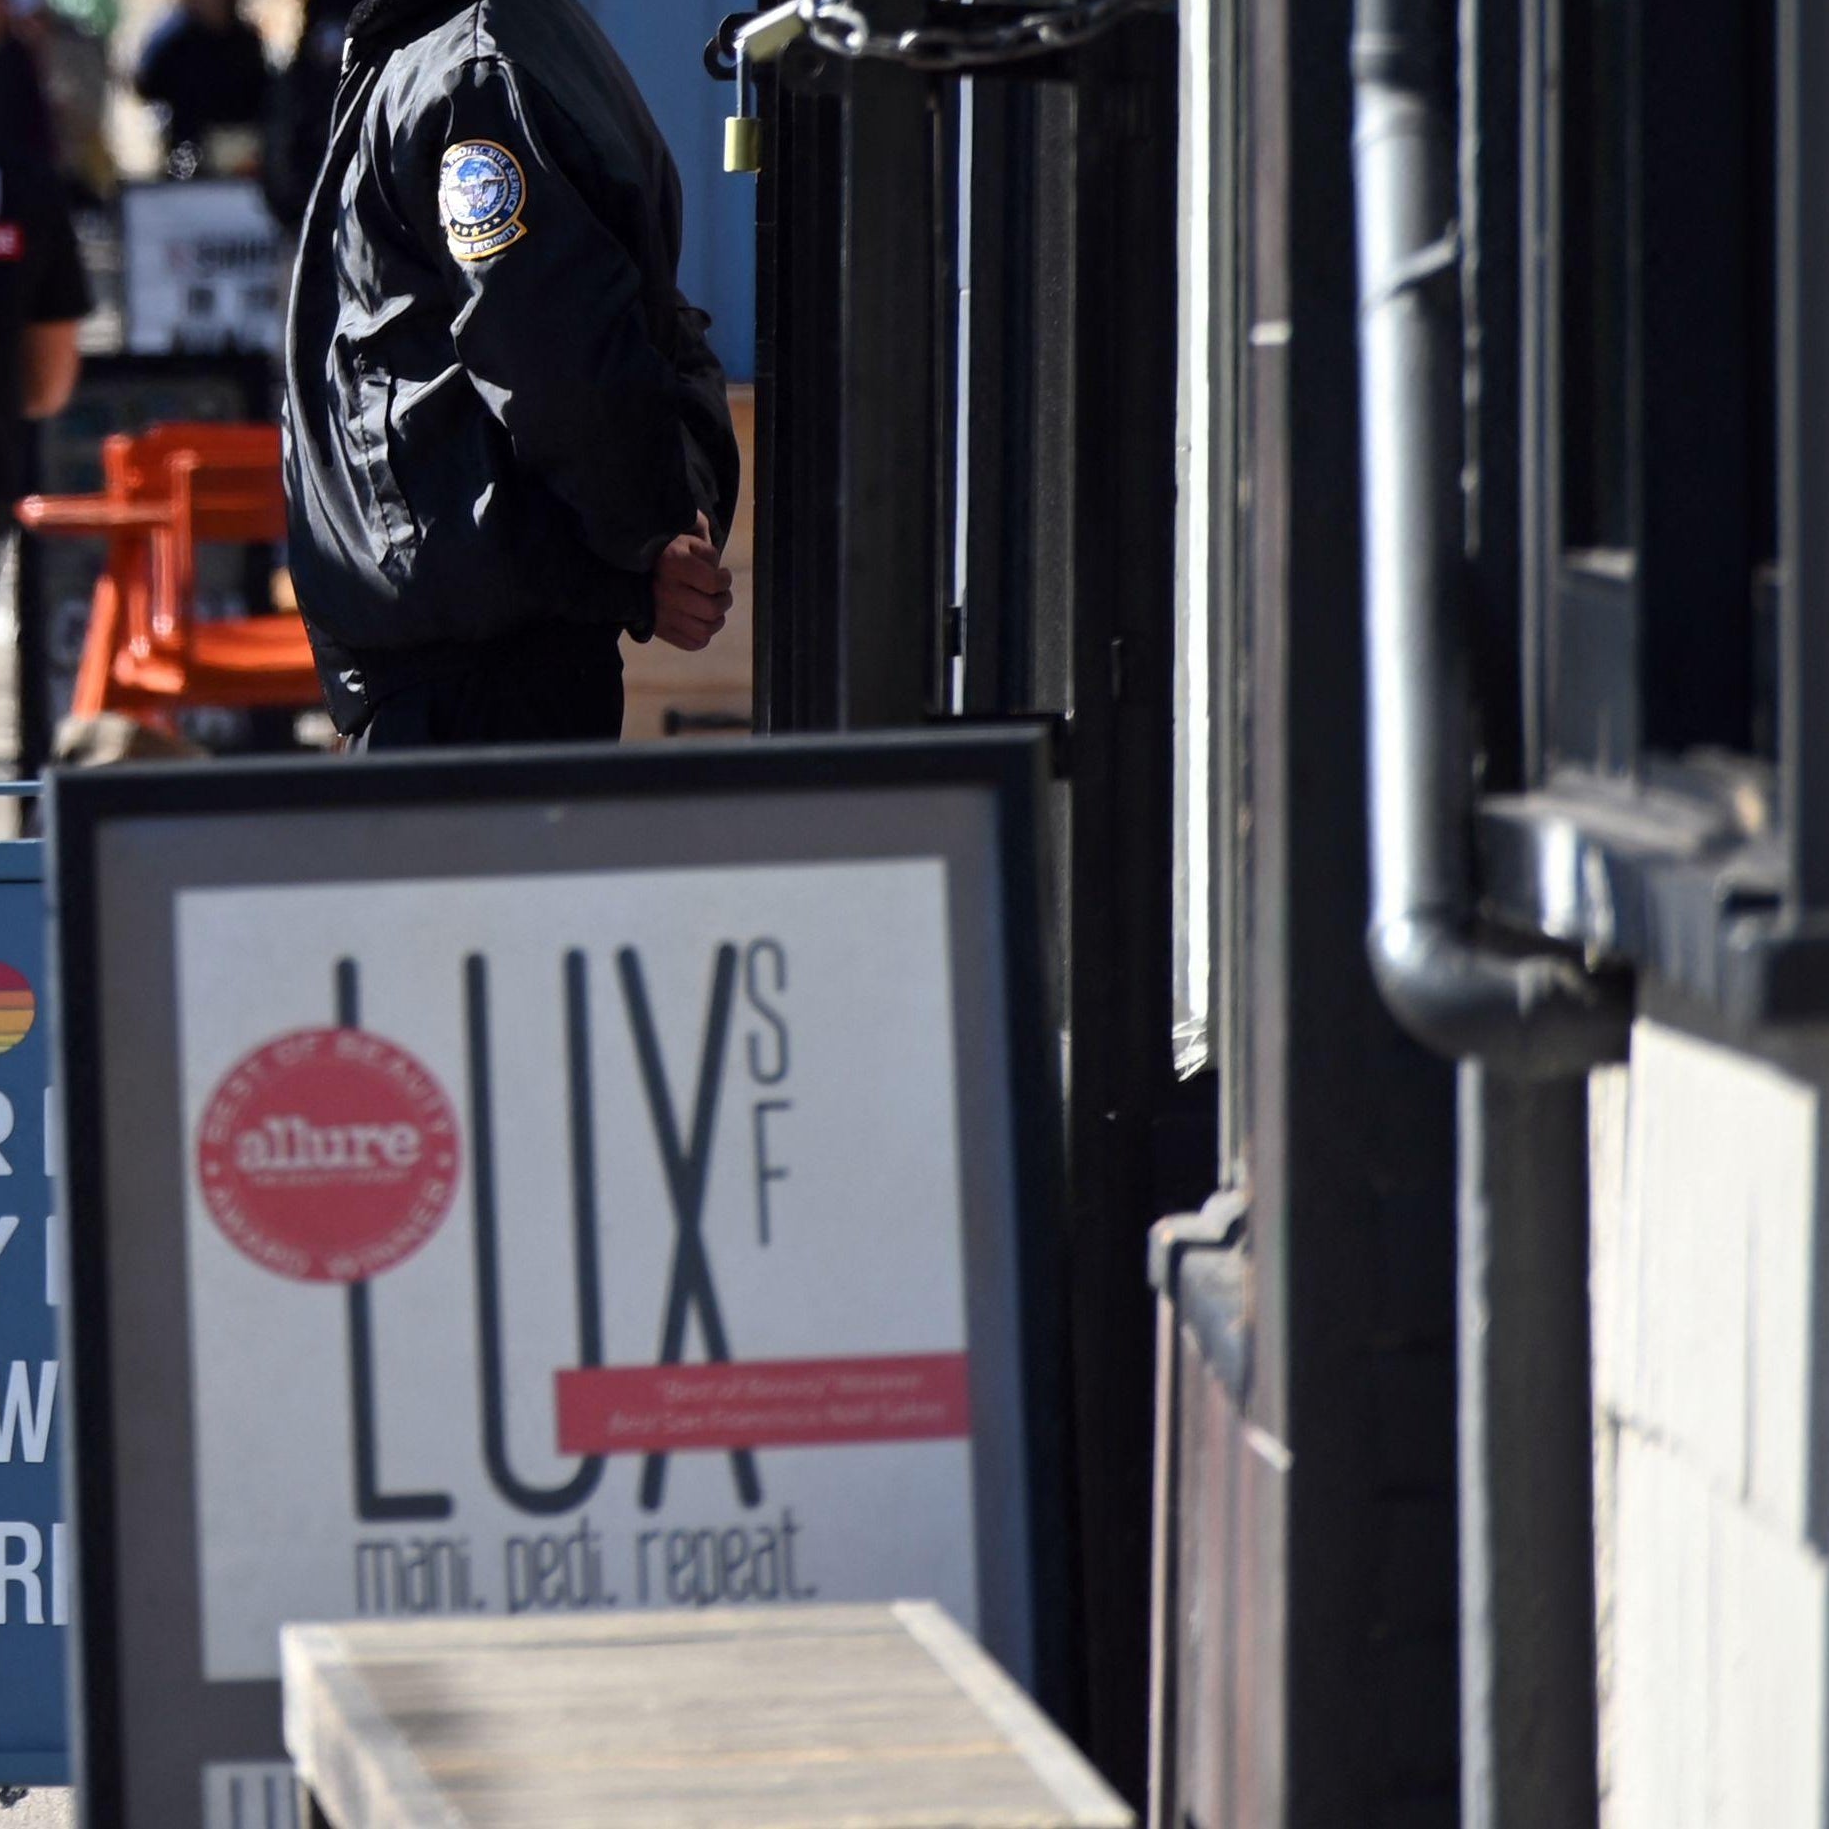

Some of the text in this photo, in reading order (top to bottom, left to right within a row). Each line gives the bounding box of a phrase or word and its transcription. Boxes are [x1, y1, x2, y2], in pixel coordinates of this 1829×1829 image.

[505, 167, 521, 214] SERVICE
[237, 1116, 420, 1171] allure
[334, 942, 763, 1520] LUX
[355, 1506, 818, 1614] mani. pedi. repeat.
